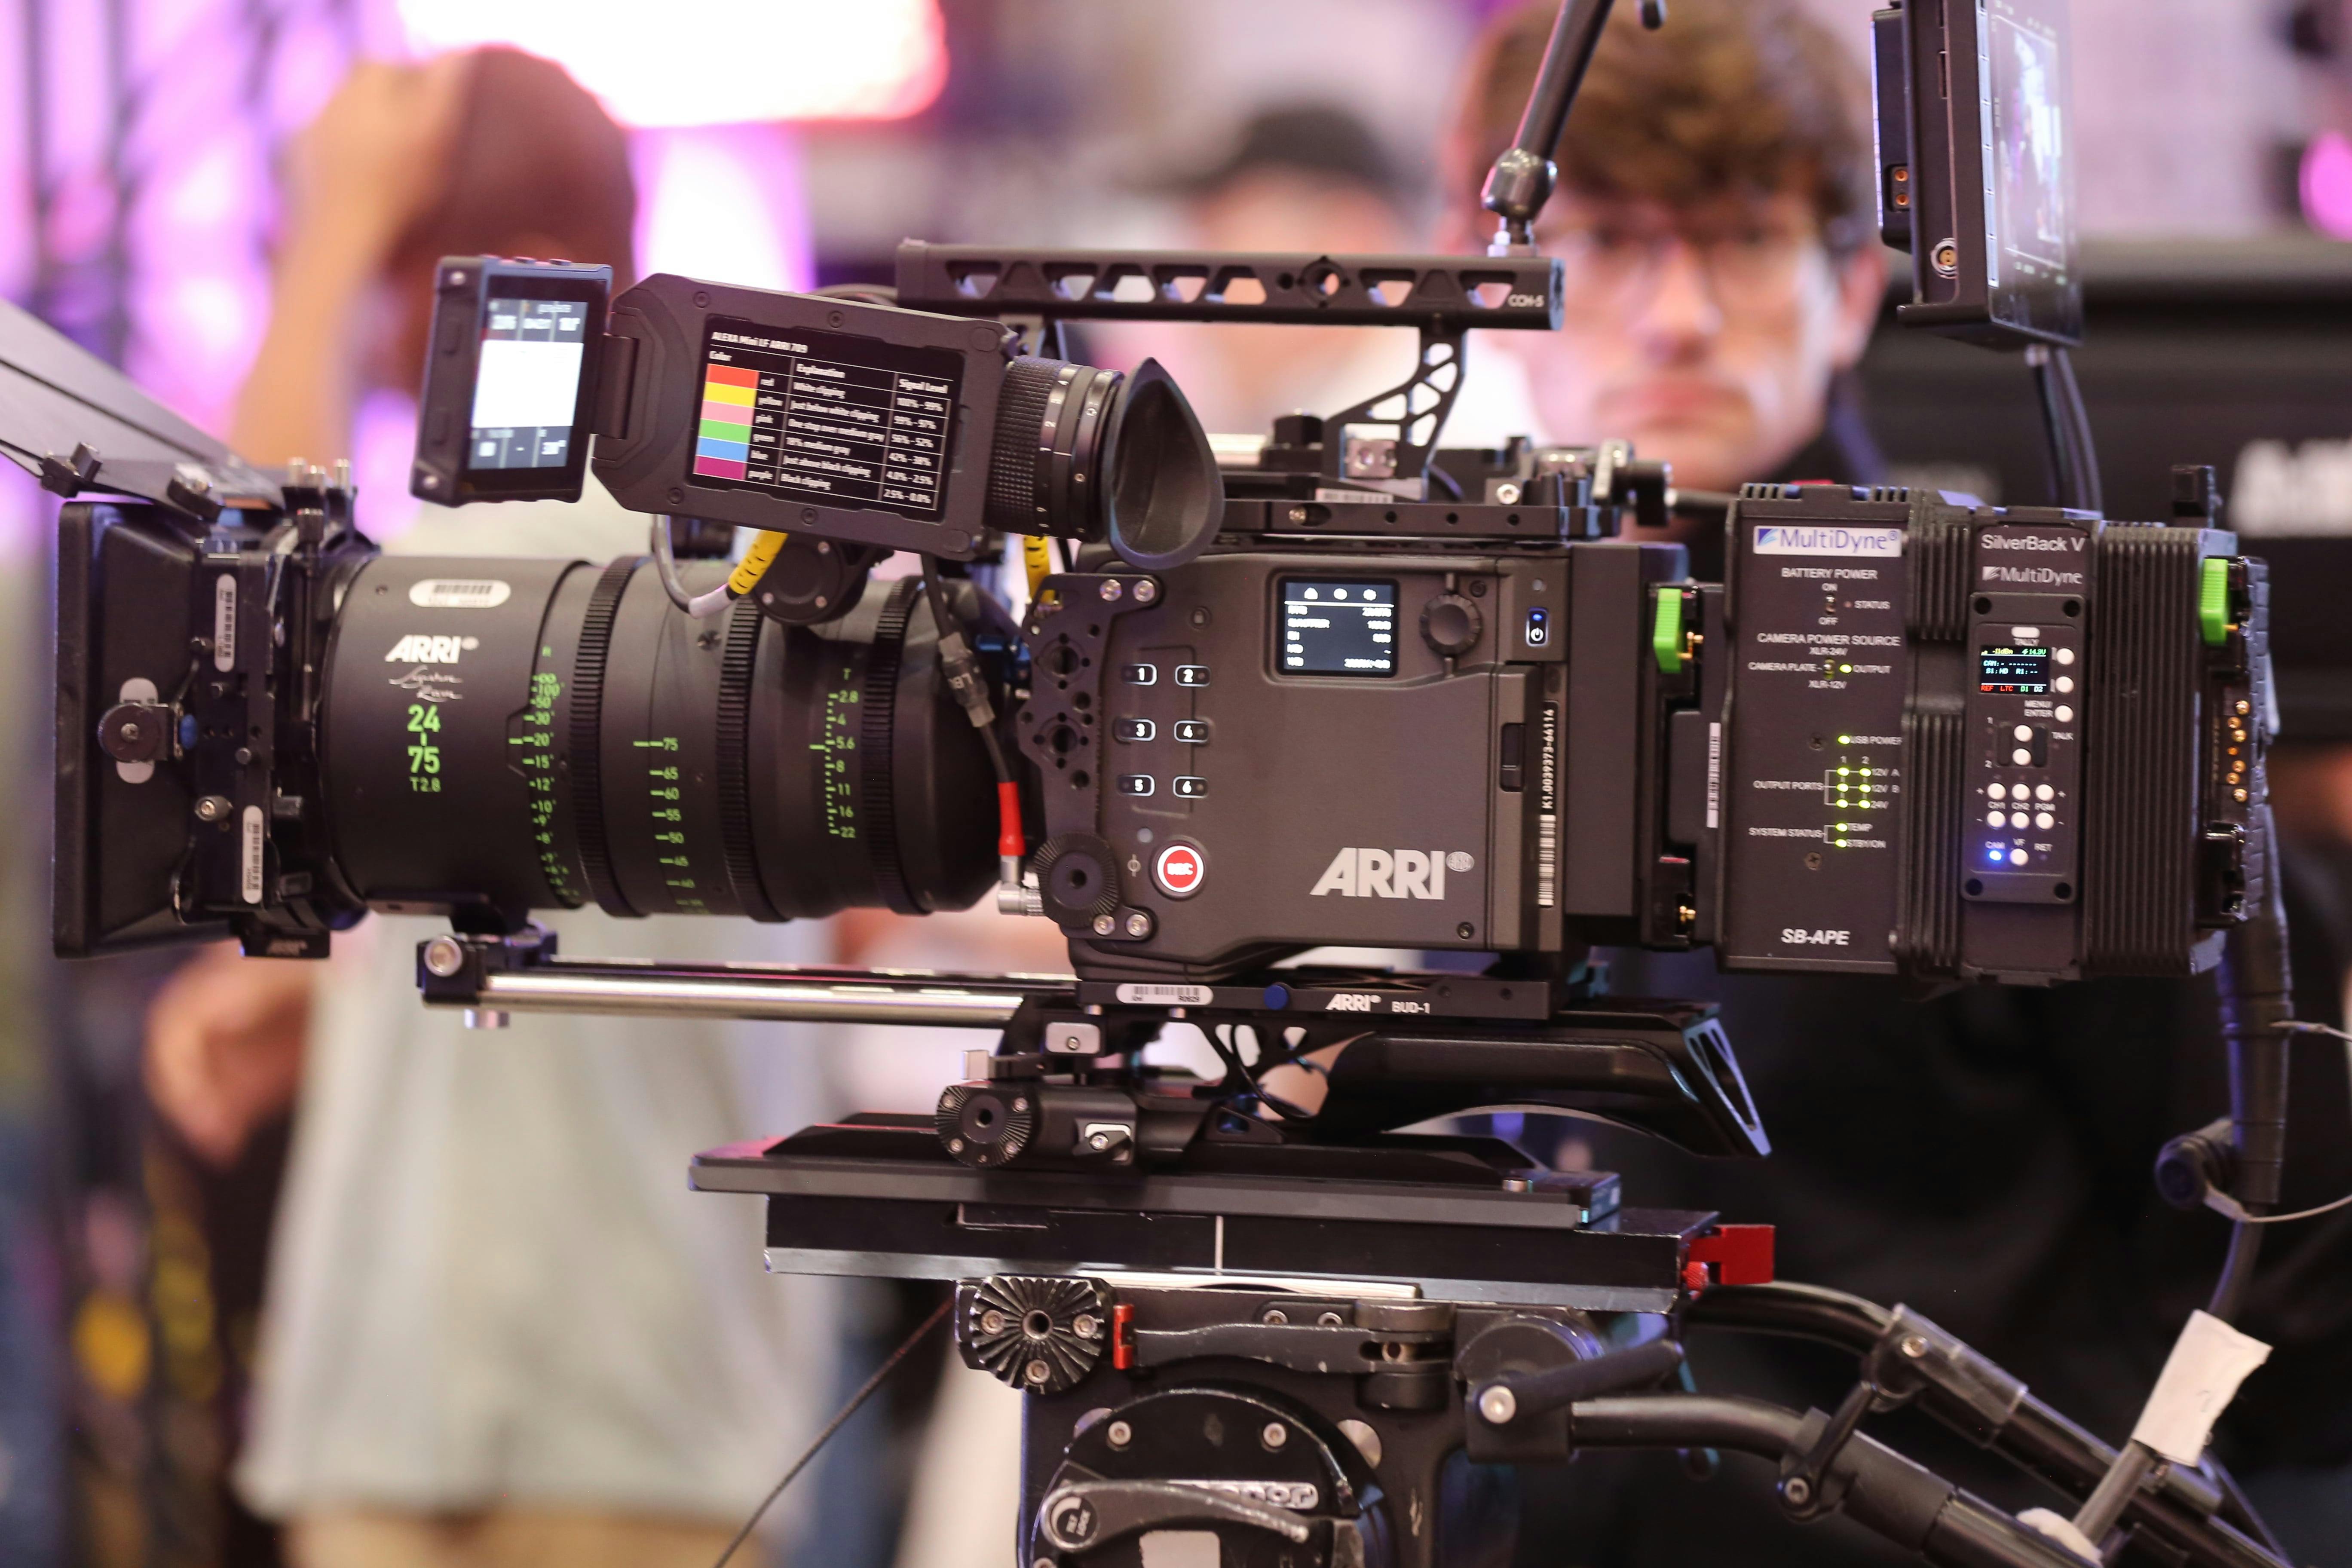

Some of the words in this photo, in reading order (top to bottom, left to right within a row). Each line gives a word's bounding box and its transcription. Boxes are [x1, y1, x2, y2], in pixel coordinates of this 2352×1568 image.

[711, 332, 738, 343] ALEXA
[709, 351, 732, 361] Color
[796, 363, 845, 379] Explanation
[760, 378, 775, 386] red
[899, 378, 925, 391] Signal
[925, 382, 948, 394] Level
[793, 382, 816, 393] White
[816, 385, 846, 399] clipping
[758, 396, 783, 406] yellow
[790, 400, 806, 410] Just
[806, 402, 828, 413] below
[829, 406, 850, 417] white
[850, 409, 879, 423] clipping
[755, 414, 773, 424] pink
[788, 419, 803, 429] One
[803, 422, 821, 432] stop
[838, 428, 867, 438] medium
[867, 432, 885, 442] gray
[752, 434, 775, 443] green
[786, 437, 803, 447] 18%
[803, 441, 833, 451] medium
[833, 445, 851, 456] gray
[750, 450, 769, 460] blue
[783, 455, 799, 465] Just
[799, 458, 821, 468] above
[821, 461, 841, 472] black
[842, 464, 871, 478] clipping
[748, 470, 773, 480] purple
[781, 473, 801, 484] Black
[801, 477, 831, 491] clipping
[1981, 534, 2067, 551] SilverBack
[2070, 537, 2086, 552] V
[1782, 567, 1833, 578] BATTERY
[1834, 569, 1878, 579] POWER
[2000, 566, 2083, 586] MultiDyne
[1822, 583, 1838, 591] ON
[1854, 600, 1890, 609] STATUS
[1818, 617, 1839, 625] OFF
[1757, 633, 1805, 643] CAMERA
[1807, 634, 1850, 645] POWER
[1851, 635, 1901, 646] SOURCE
[385, 634, 462, 664] ARRI
[1809, 646, 1848, 656] XLR-24V
[1748, 662, 1788, 671] CAMERA
[1788, 663, 1818, 672] PLATE
[1853, 665, 1892, 674] OUTPUT
[843, 668, 851, 680] T
[1138, 667, 1145, 681] 1
[1183, 668, 1194, 683] 2
[1808, 680, 1847, 689] XLR-12V
[839, 690, 859, 704] 2.8
[407, 704, 441, 733] 24
[837, 713, 847, 726] 4
[2024, 709, 2054, 718] ENTER
[1136, 723, 1146, 737] 3
[1183, 725, 1193, 738] 4
[836, 735, 855, 750] 5.6
[2052, 732, 2074, 741] TALK
[663, 737, 679, 752] 75
[407, 745, 441, 774] 75
[1861, 756, 1870, 764] 2
[1985, 760, 1993, 769] 2
[836, 759, 845, 773] 8
[663, 766, 679, 780] 65
[1891, 769, 1901, 777] A
[410, 776, 441, 792] T2.8
[837, 782, 851, 796] 11
[1134, 779, 1143, 792] 5
[1182, 781, 1192, 793] 6
[1753, 780, 1791, 790] OUTPUT
[1792, 781, 1825, 791] PORTS
[1892, 785, 1901, 793] B
[839, 805, 854, 818] 16
[2011, 802, 2030, 811] CH2
[2034, 803, 2056, 812] PGM
[840, 826, 856, 838] 22
[1748, 827, 1787, 837] SYSTEM
[1788, 829, 1823, 838] STATUS
[1985, 841, 2006, 849] CAM
[2013, 838, 2026, 846] VF
[2034, 843, 2053, 852] RET
[1167, 863, 1193, 875] REC
[1310, 847, 1445, 900] ARRI
[1781, 928, 1851, 946] SB-APE
[1325, 993, 1371, 1012] ARRI
[1391, 1001, 1430, 1014] BUD-1
